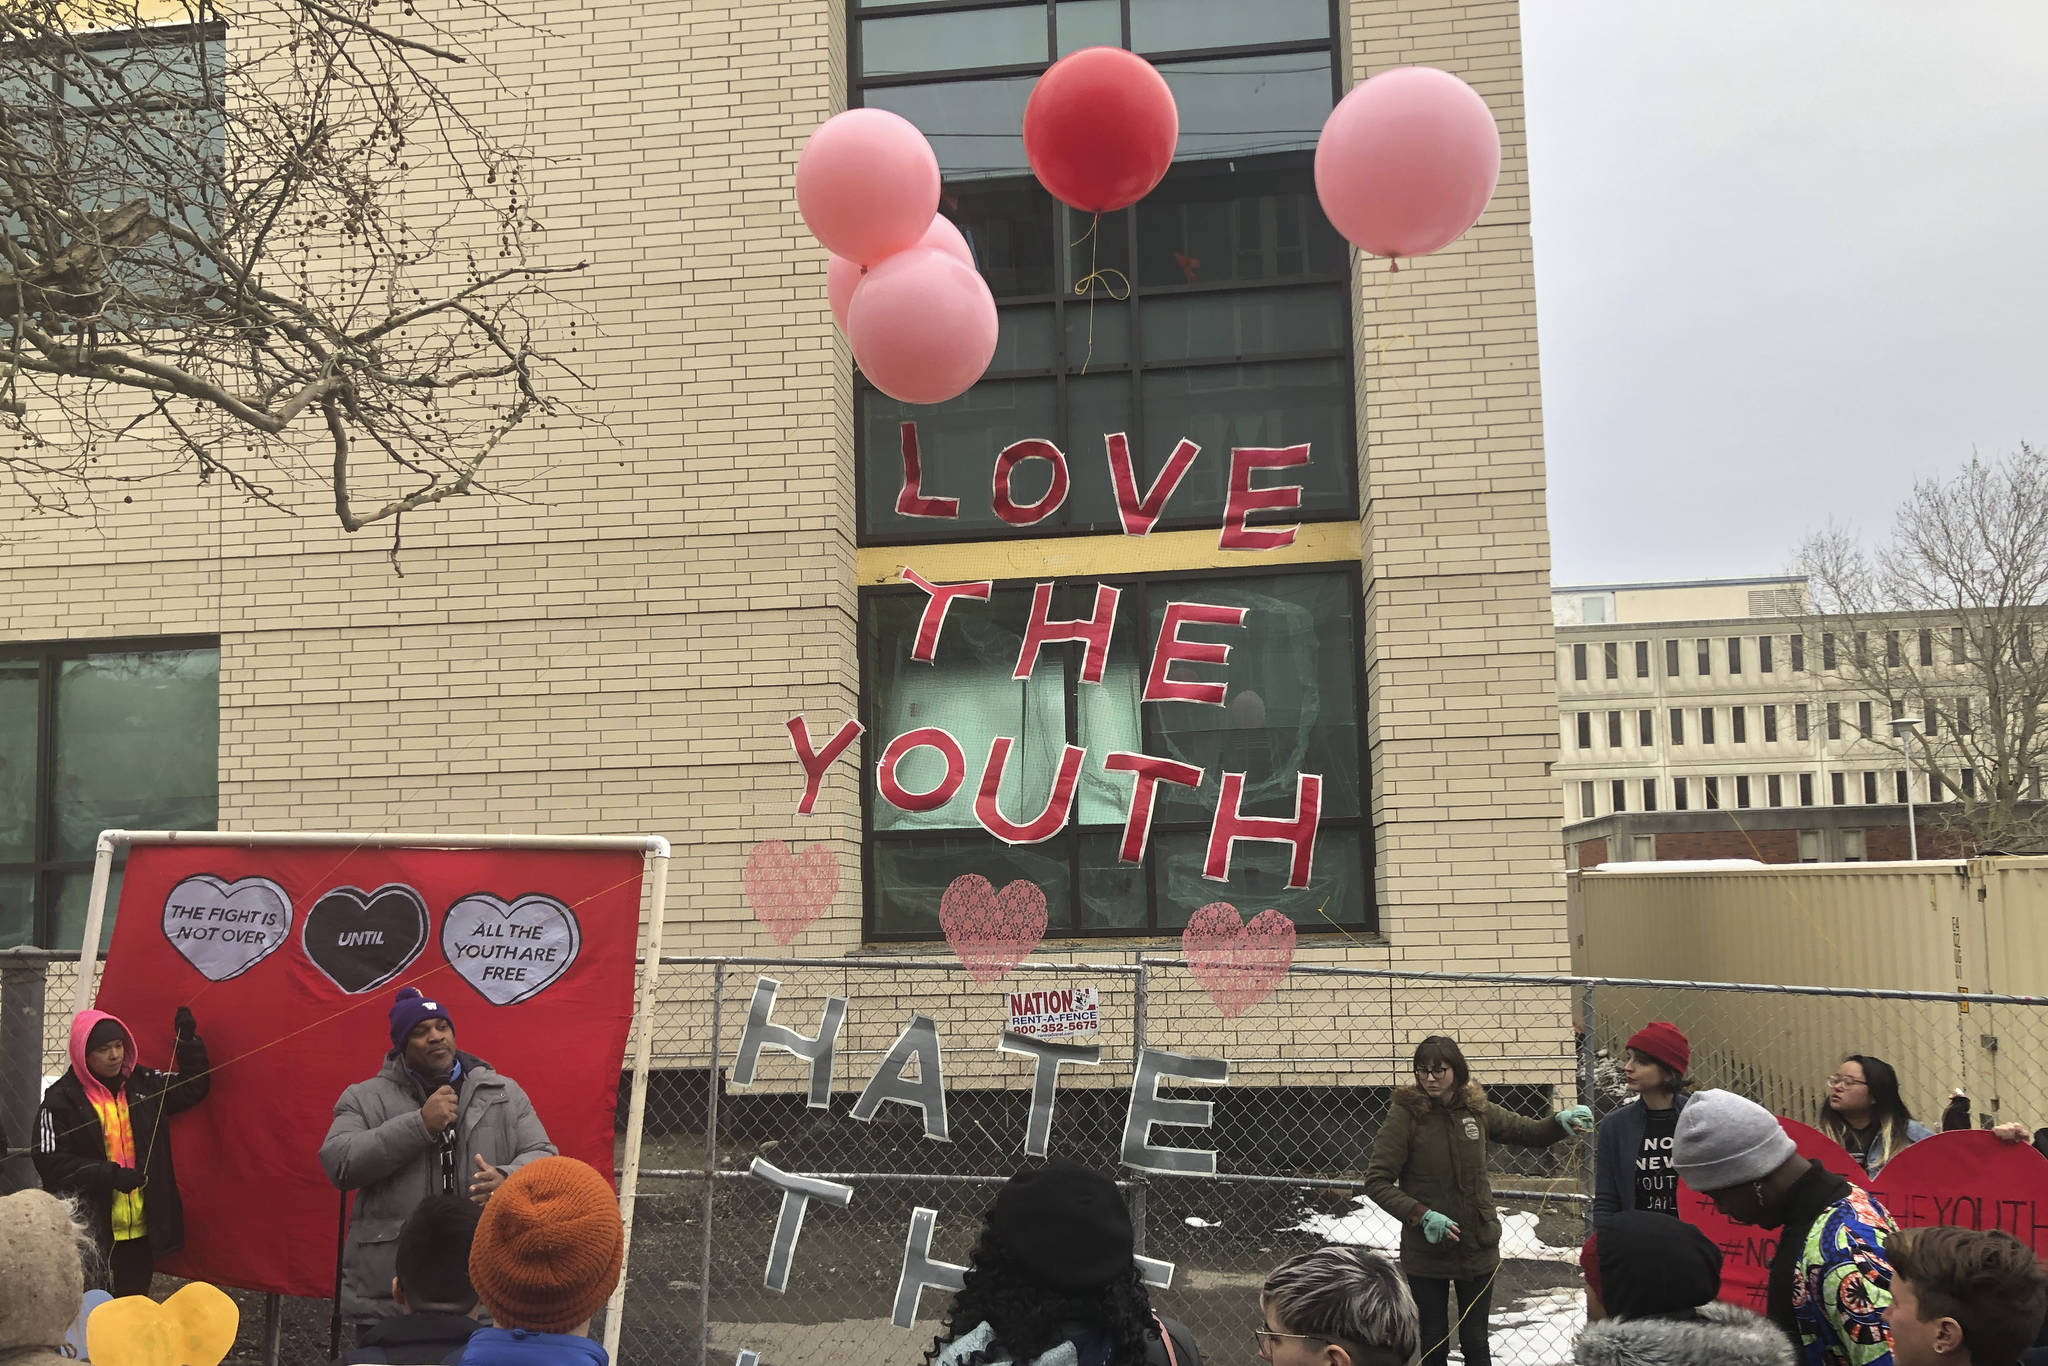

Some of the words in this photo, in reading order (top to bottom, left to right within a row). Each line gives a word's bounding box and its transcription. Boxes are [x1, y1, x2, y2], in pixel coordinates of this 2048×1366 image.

[895, 421, 1314, 551] LOVE
[902, 566, 1250, 707] THE
[785, 714, 1323, 890] YOUTH
[172, 904, 206, 920] THE
[208, 907, 262, 924] FIGHT
[261, 912, 278, 926] IS
[177, 926, 219, 941] NOT
[221, 928, 267, 944] OVER
[338, 930, 385, 946] UNTIL
[471, 922, 504, 938] ALL
[509, 924, 544, 940] THE
[454, 942, 518, 960] YOUTH
[518, 947, 557, 962] ARE
[482, 966, 527, 981] FREE
[1012, 1011, 1097, 1025] RENT-A-FENCE
[1013, 1020, 1098, 1035] 800-352-5675
[730, 976, 1230, 1177] HATE
[1644, 1136, 1675, 1151] NO
[1637, 1175, 1676, 1191] OUT
